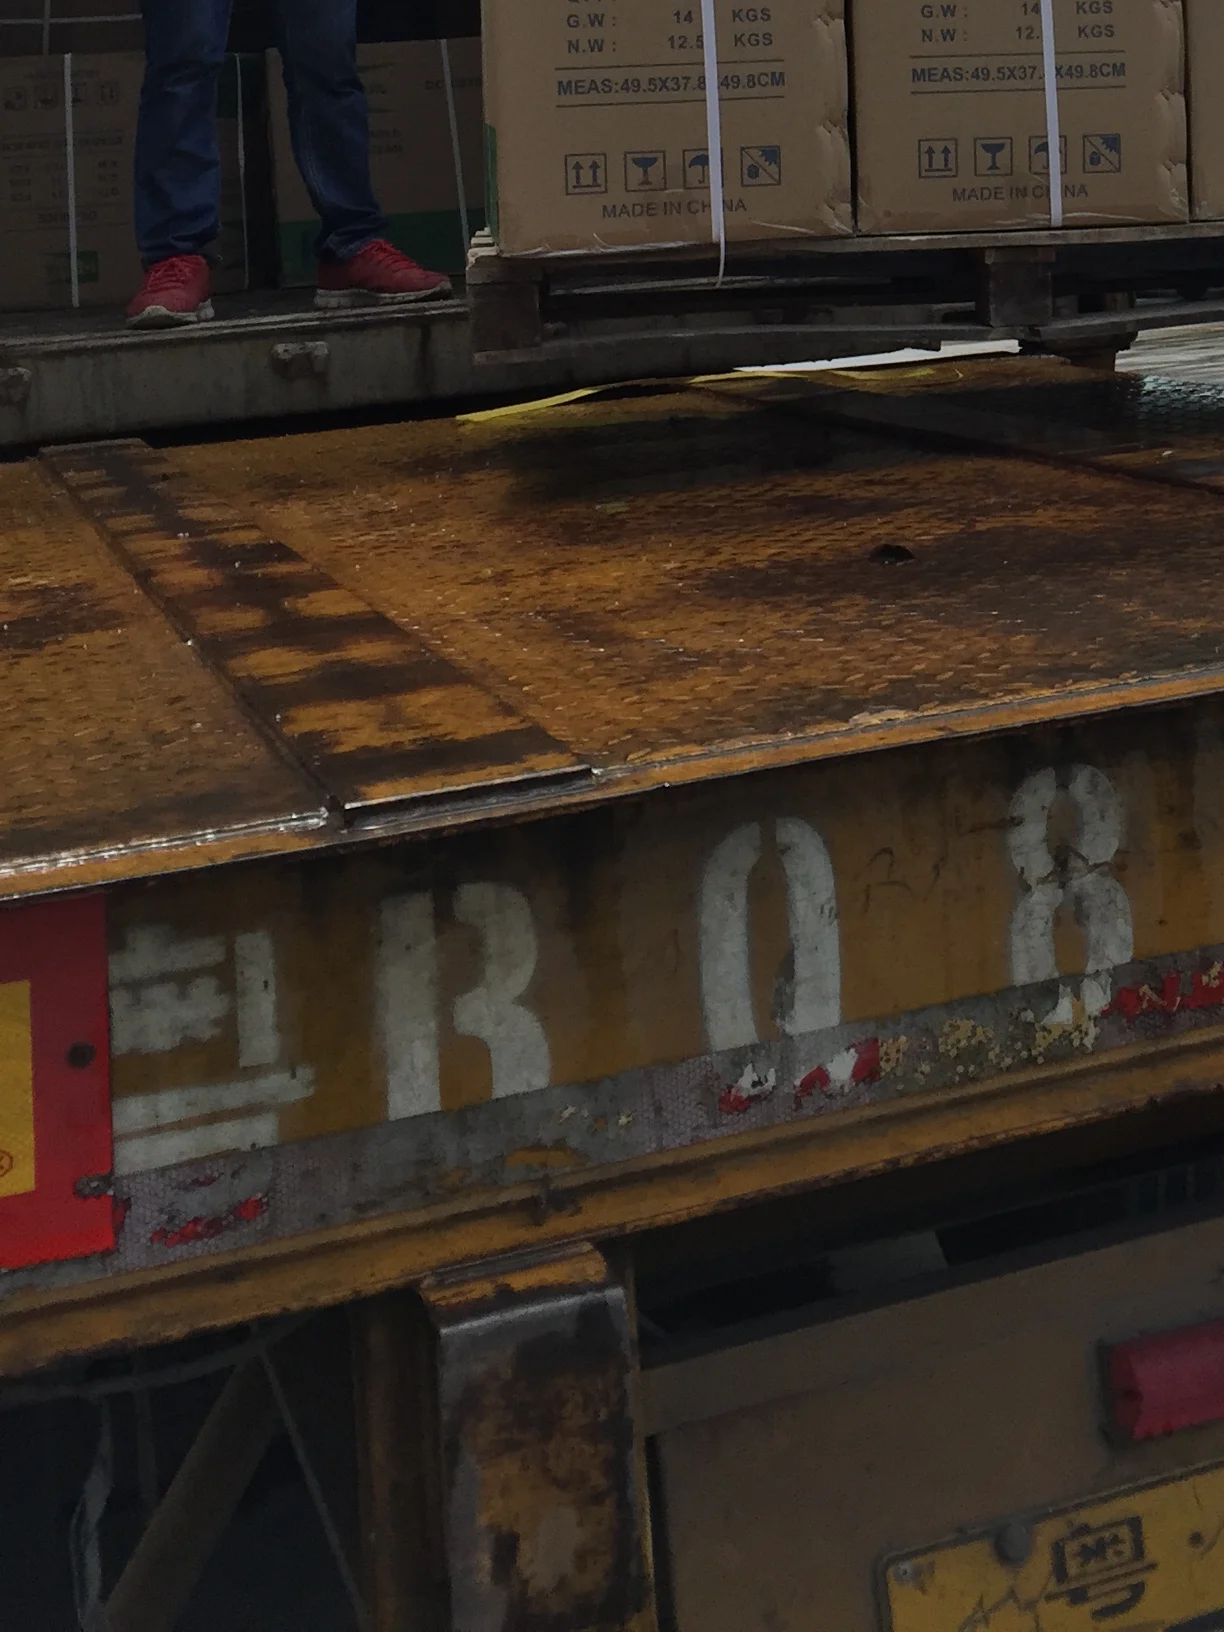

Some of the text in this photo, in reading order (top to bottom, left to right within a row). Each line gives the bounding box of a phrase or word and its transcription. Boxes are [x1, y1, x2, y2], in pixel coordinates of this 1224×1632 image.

[673, 10, 694, 24] 14
[732, 7, 771, 23] KGS
[1022, 2, 1040, 15] 14
[1076, 1, 1113, 15] KGS
[1015, 25, 1040, 40] 12.
[1078, 24, 1114, 39] KGS
[668, 34, 704, 50] 12.5
[734, 32, 773, 48] KGS
[952, 186, 1004, 202] MADE
[1009, 186, 1027, 200] IN
[602, 202, 657, 219] MADE
[663, 201, 681, 216] IN
